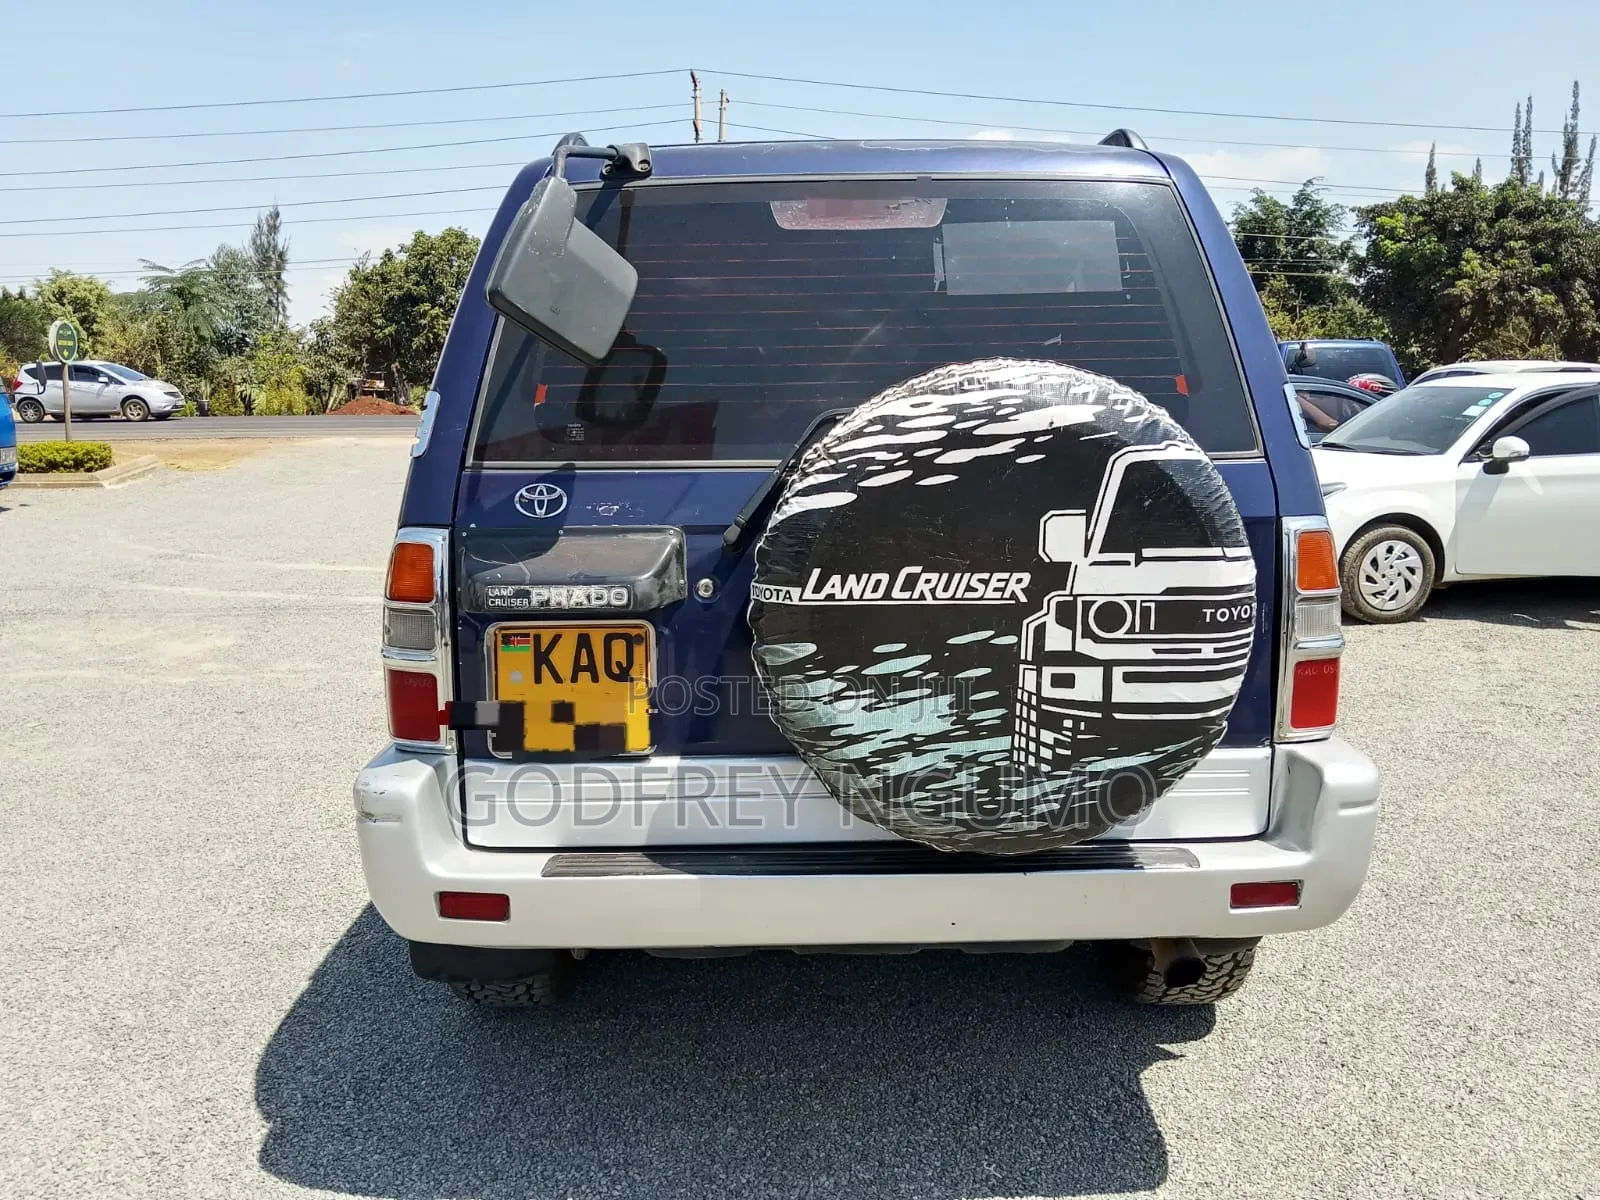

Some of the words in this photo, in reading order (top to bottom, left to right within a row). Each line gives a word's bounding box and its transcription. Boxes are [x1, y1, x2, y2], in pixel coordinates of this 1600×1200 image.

[488, 587, 514, 597] LAND
[752, 585, 793, 602] TOYOTA
[801, 567, 890, 600] LAND
[891, 565, 1032, 603] CRUISER
[488, 598, 529, 607] CRUISER
[530, 586, 629, 608] PRADO
[533, 632, 634, 684] KAQ
